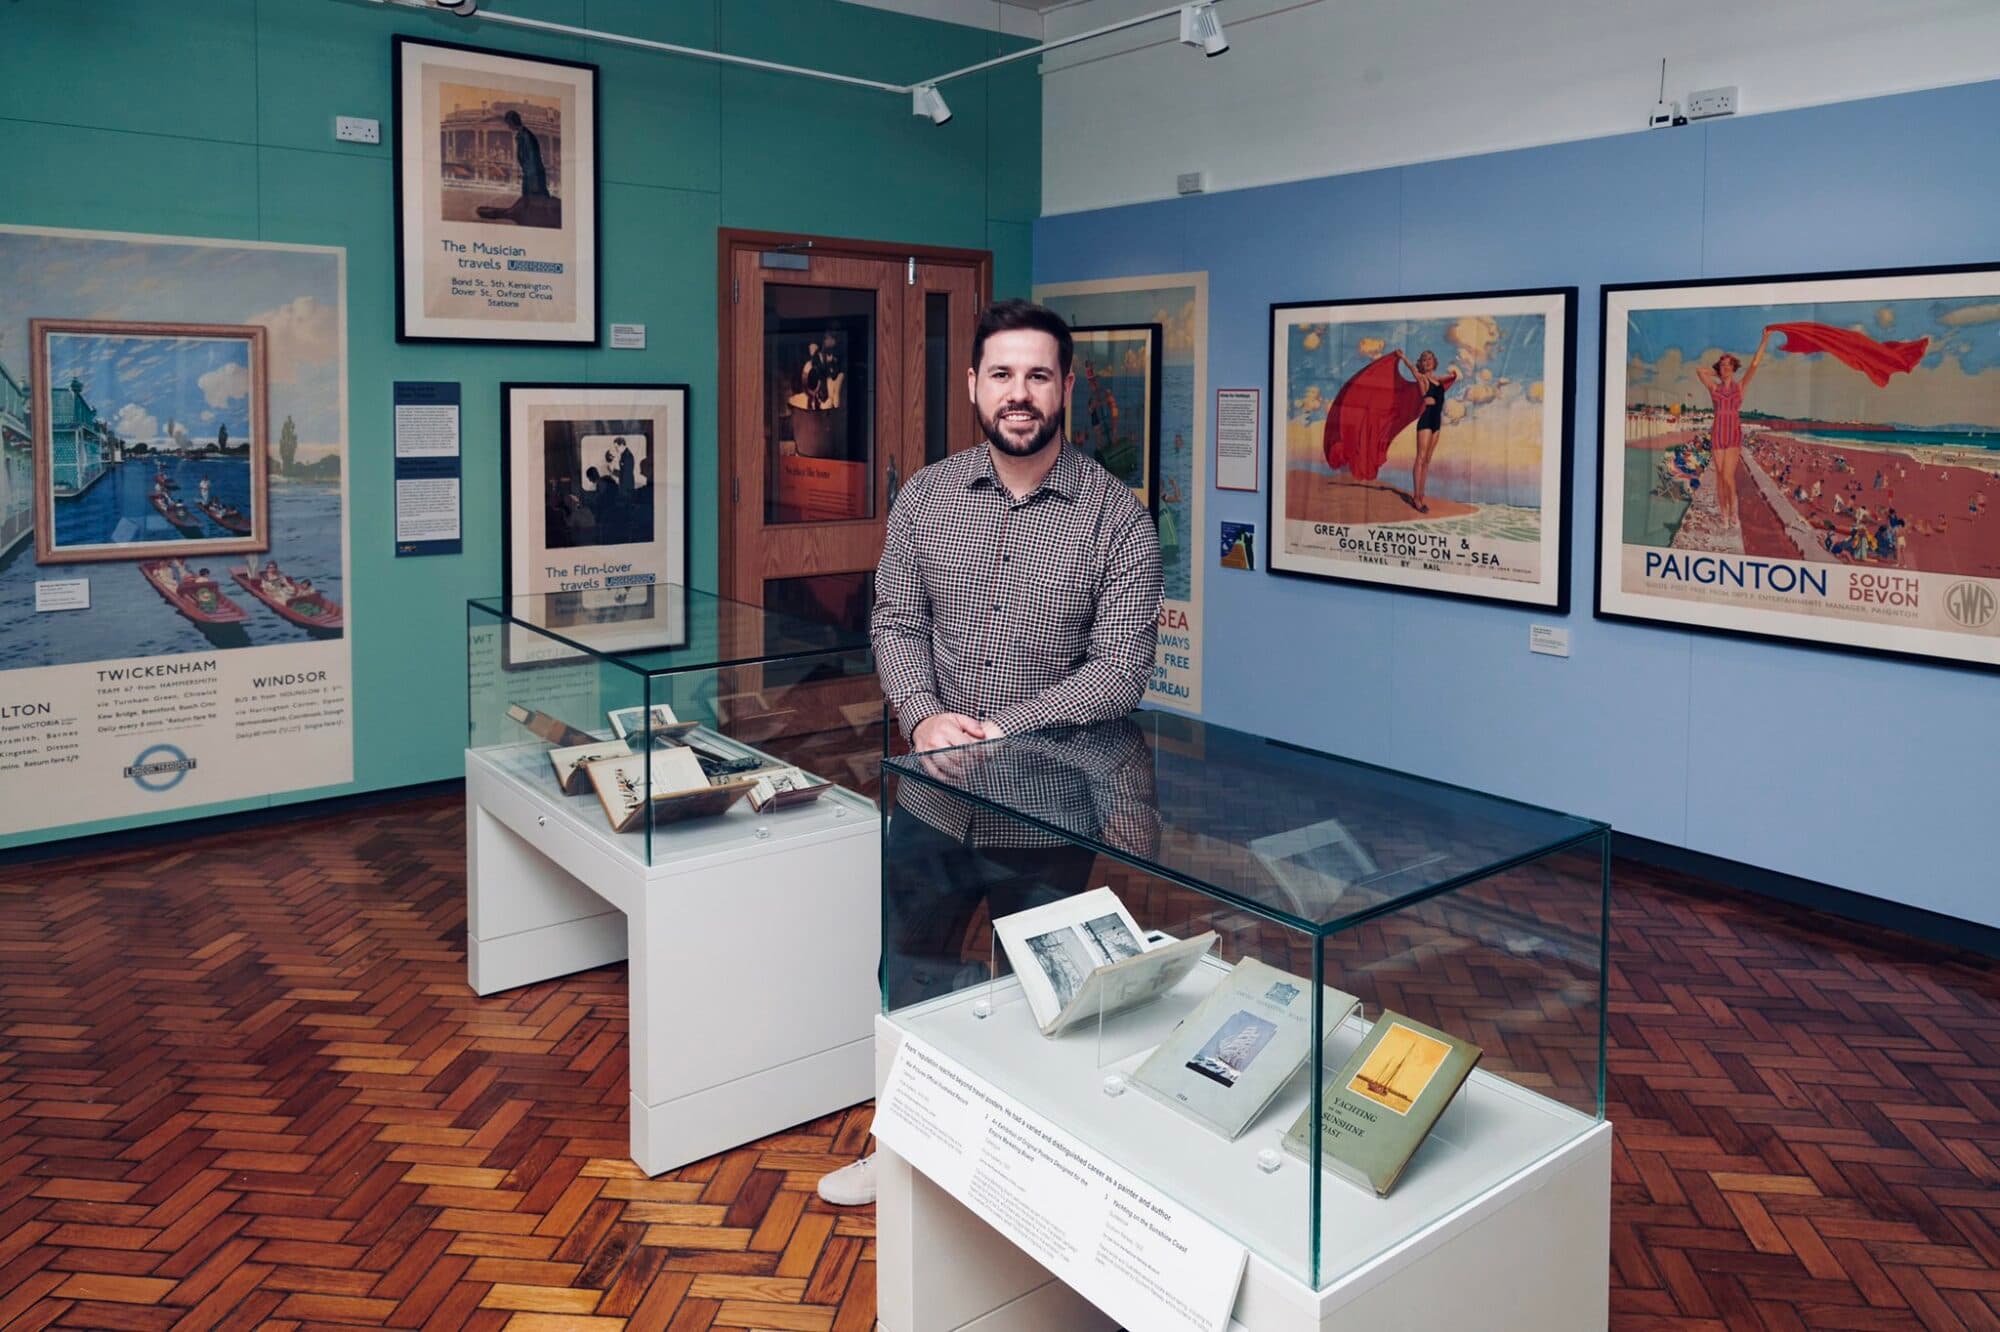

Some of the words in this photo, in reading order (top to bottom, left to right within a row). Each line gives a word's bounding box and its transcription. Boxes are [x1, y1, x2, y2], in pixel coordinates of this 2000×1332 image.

[442, 240, 467, 253] The
[473, 242, 527, 257] Musician
[459, 259, 502, 270] travels
[452, 278, 472, 287] Bond
[452, 288, 476, 296] Dover
[497, 289, 526, 299] Oxford
[529, 291, 553, 301] Circus
[488, 299, 519, 308] Stations
[1314, 524, 1350, 538] GREAT
[1368, 529, 1447, 548] YARMOUTH
[1460, 538, 1470, 550] &
[545, 567, 568, 578] The
[574, 563, 633, 576] Film-lover
[1359, 555, 1389, 566] TRAVEL
[1423, 563, 1441, 572] RAIL
[1645, 551, 1827, 597] PAIGNTON
[1849, 572, 1919, 593] SOUTH
[561, 579, 600, 592] travels
[1849, 587, 1919, 608] DEVON
[1946, 583, 1994, 625] GWR
[1158, 609, 1189, 631] SEA
[1157, 633, 1190, 651] WAYS
[1164, 653, 1190, 670] FREE
[97, 660, 217, 682] TWICKENHAM
[253, 671, 326, 688] WINDSOR
[1148, 680, 1190, 698] BUREAU
[1, 702, 51, 718] LTON
[1334, 1097, 1378, 1122] YACHTING
[1323, 1112, 1366, 1137] SUNSHINE
[1117, 1183, 1139, 1199] painter
[1138, 1196, 1151, 1208] and
